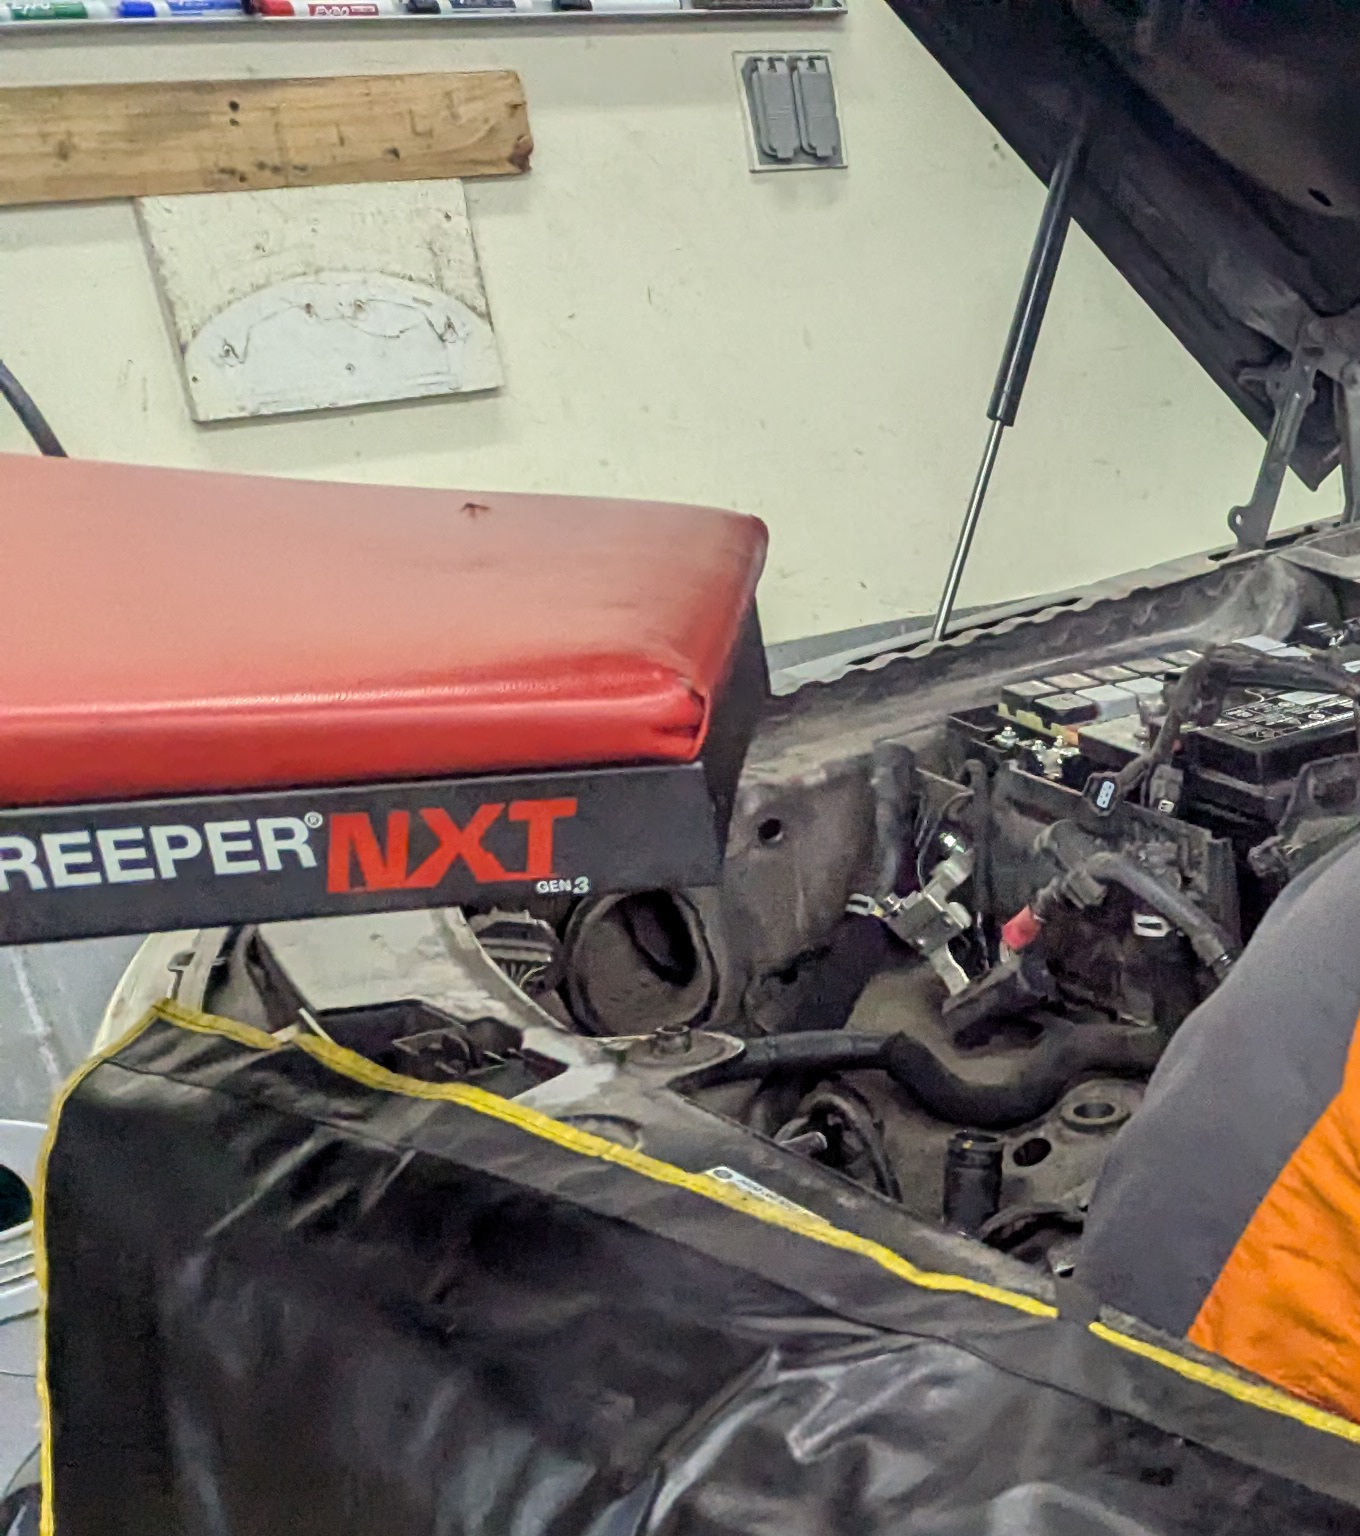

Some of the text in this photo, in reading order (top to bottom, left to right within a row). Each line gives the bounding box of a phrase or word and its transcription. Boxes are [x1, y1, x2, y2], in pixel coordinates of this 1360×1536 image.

[327, 797, 578, 893] NXT
[536, 876, 590, 894] GEN 3
